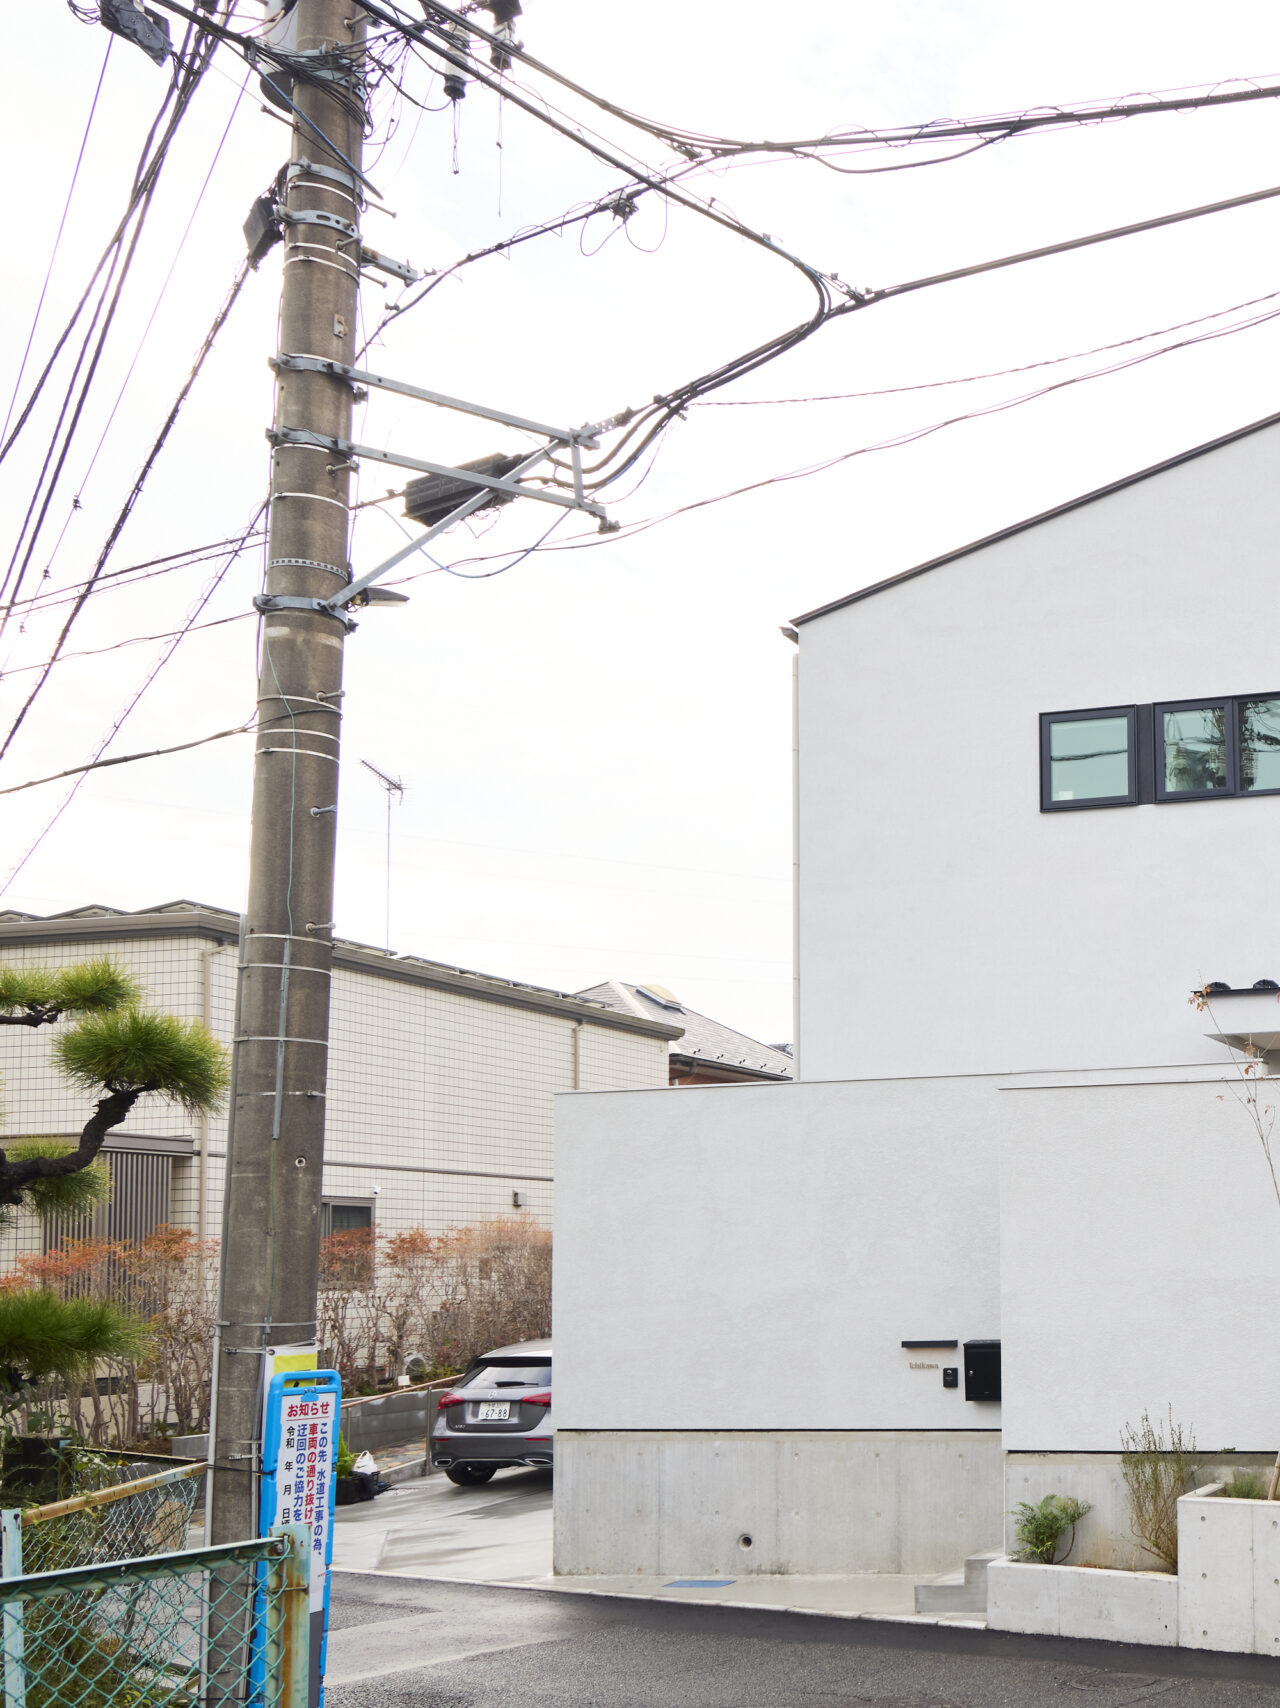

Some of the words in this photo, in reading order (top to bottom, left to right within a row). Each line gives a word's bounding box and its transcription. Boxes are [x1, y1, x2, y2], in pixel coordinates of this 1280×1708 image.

[287, 1402, 330, 1417] お知らせ
[285, 1426, 295, 1449] 令和
[317, 1422, 328, 1463] この先
[284, 1461, 293, 1472] 年
[293, 1423, 308, 1522] 迂回のご協力を
[304, 1422, 319, 1526] 車両の通り抜け
[282, 1484, 292, 1496] 月
